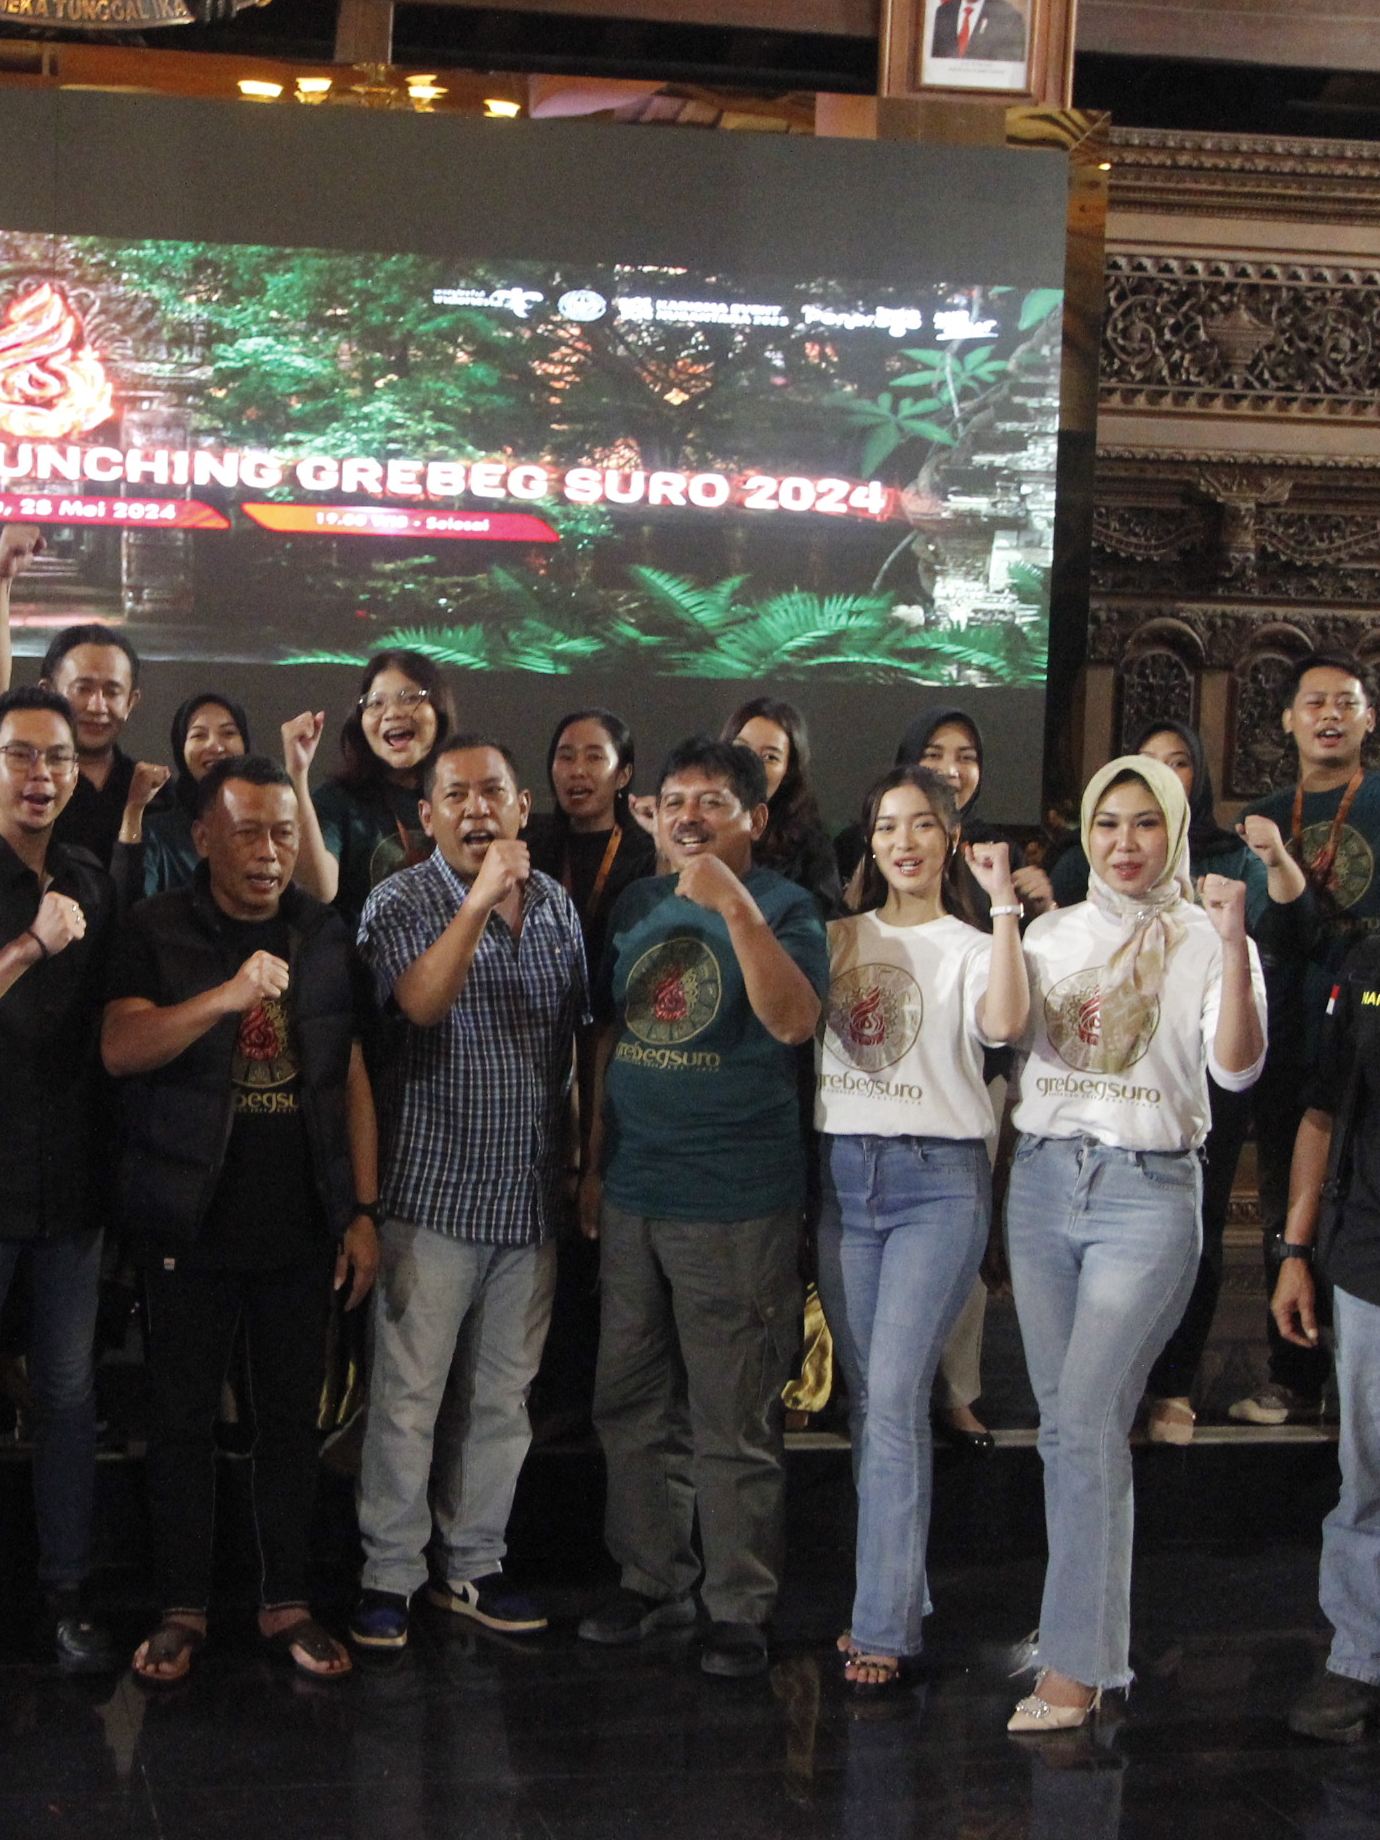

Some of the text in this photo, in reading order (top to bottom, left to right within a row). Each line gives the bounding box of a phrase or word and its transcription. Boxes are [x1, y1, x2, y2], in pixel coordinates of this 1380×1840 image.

[296, 456, 549, 500] GREBEG
[564, 468, 730, 508] SURO
[740, 475, 886, 514] 2024
[20, 498, 53, 515] 28
[59, 500, 106, 517] Mei
[113, 502, 176, 520] 2024
[818, 1070, 924, 1100] rebegsuro
[1036, 1072, 1161, 1104] grebegsuro
